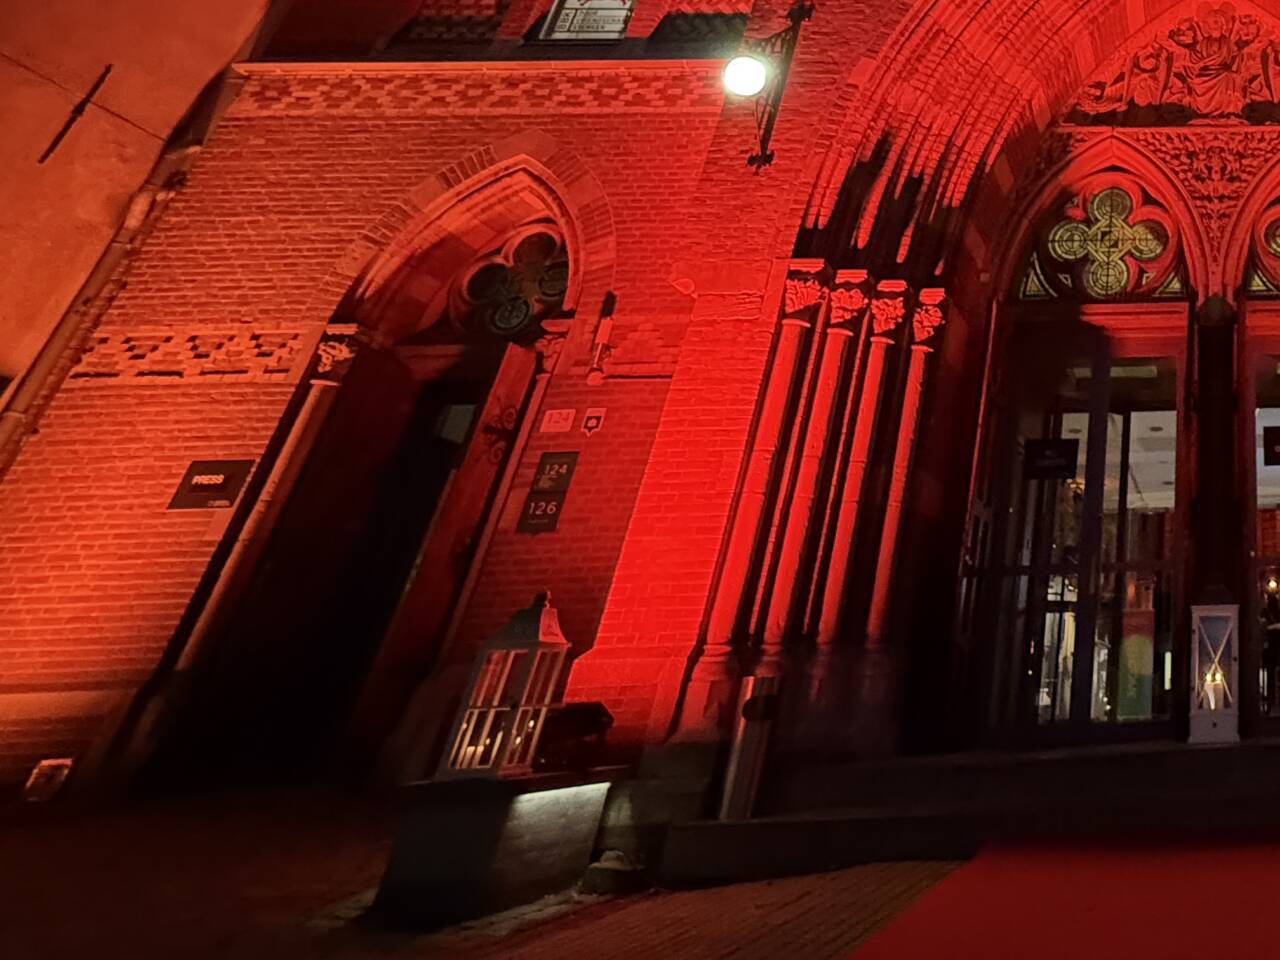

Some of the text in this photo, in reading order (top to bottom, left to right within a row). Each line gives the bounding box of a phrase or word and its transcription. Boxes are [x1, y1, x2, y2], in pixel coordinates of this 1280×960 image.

[544, 464, 568, 475] 124
[191, 474, 225, 485] PRESS
[528, 502, 557, 515] 126
